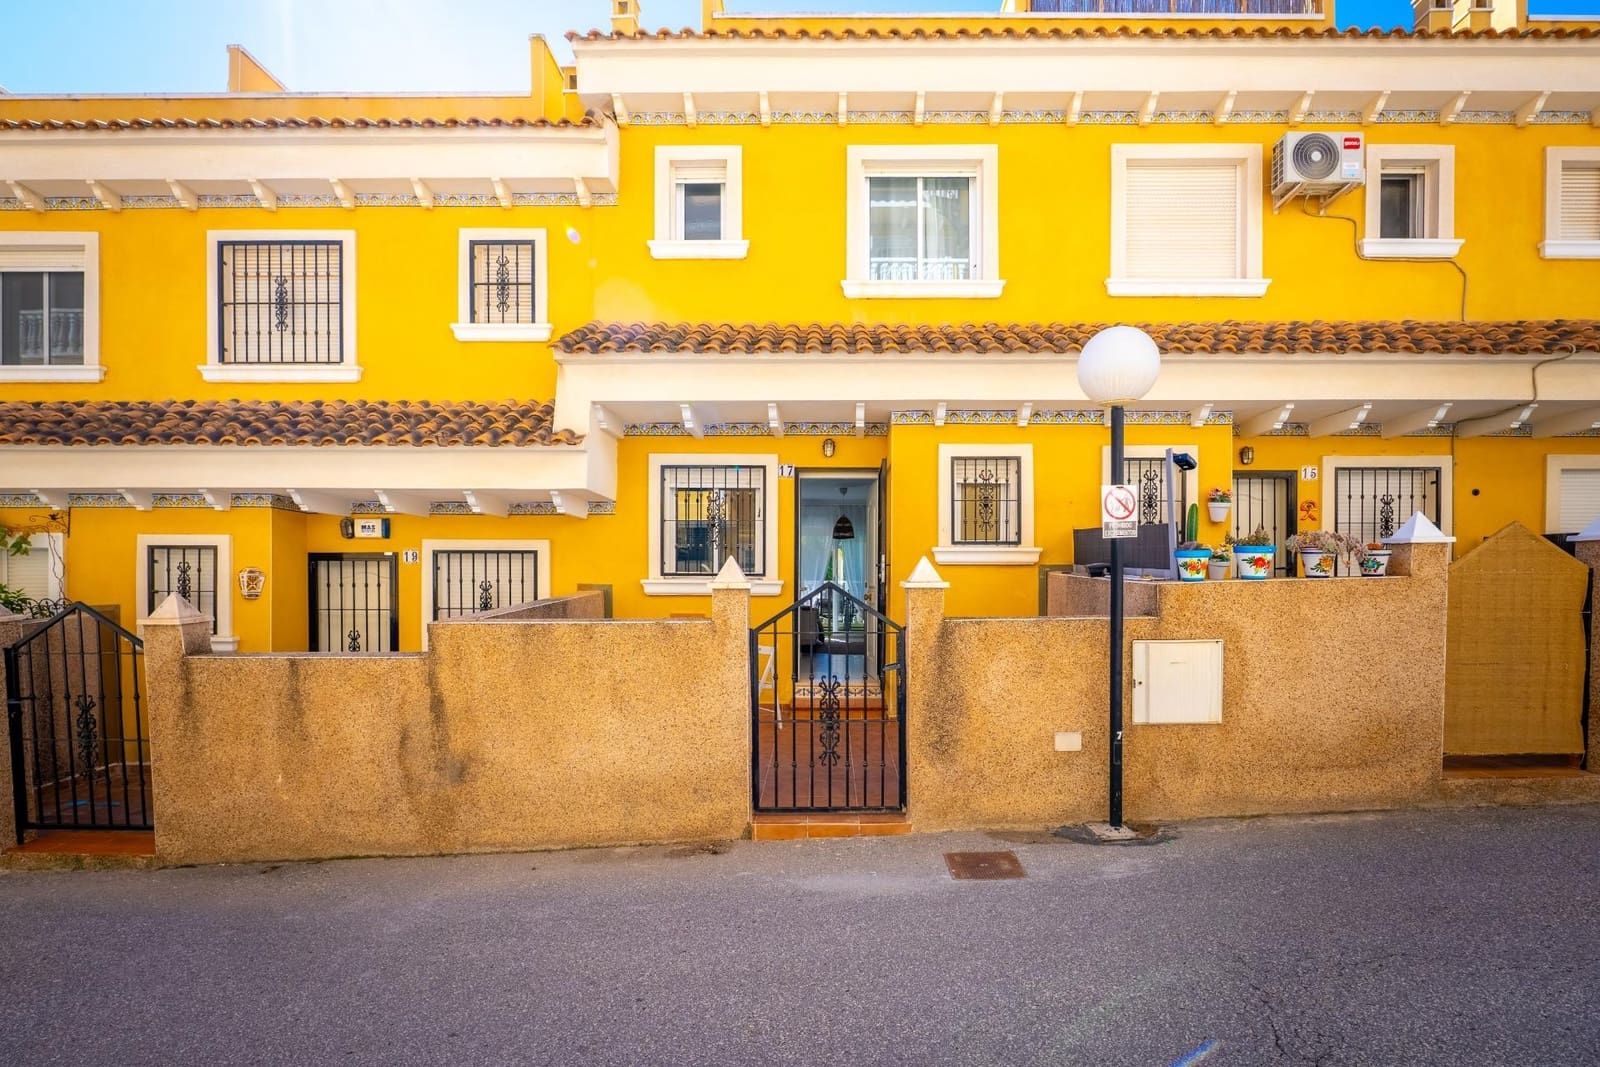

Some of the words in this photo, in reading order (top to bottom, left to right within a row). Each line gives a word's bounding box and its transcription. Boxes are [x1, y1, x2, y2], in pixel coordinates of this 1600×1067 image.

[780, 465, 793, 476] 17
[1303, 468, 1317, 479] 15
[405, 551, 418, 562] 19
